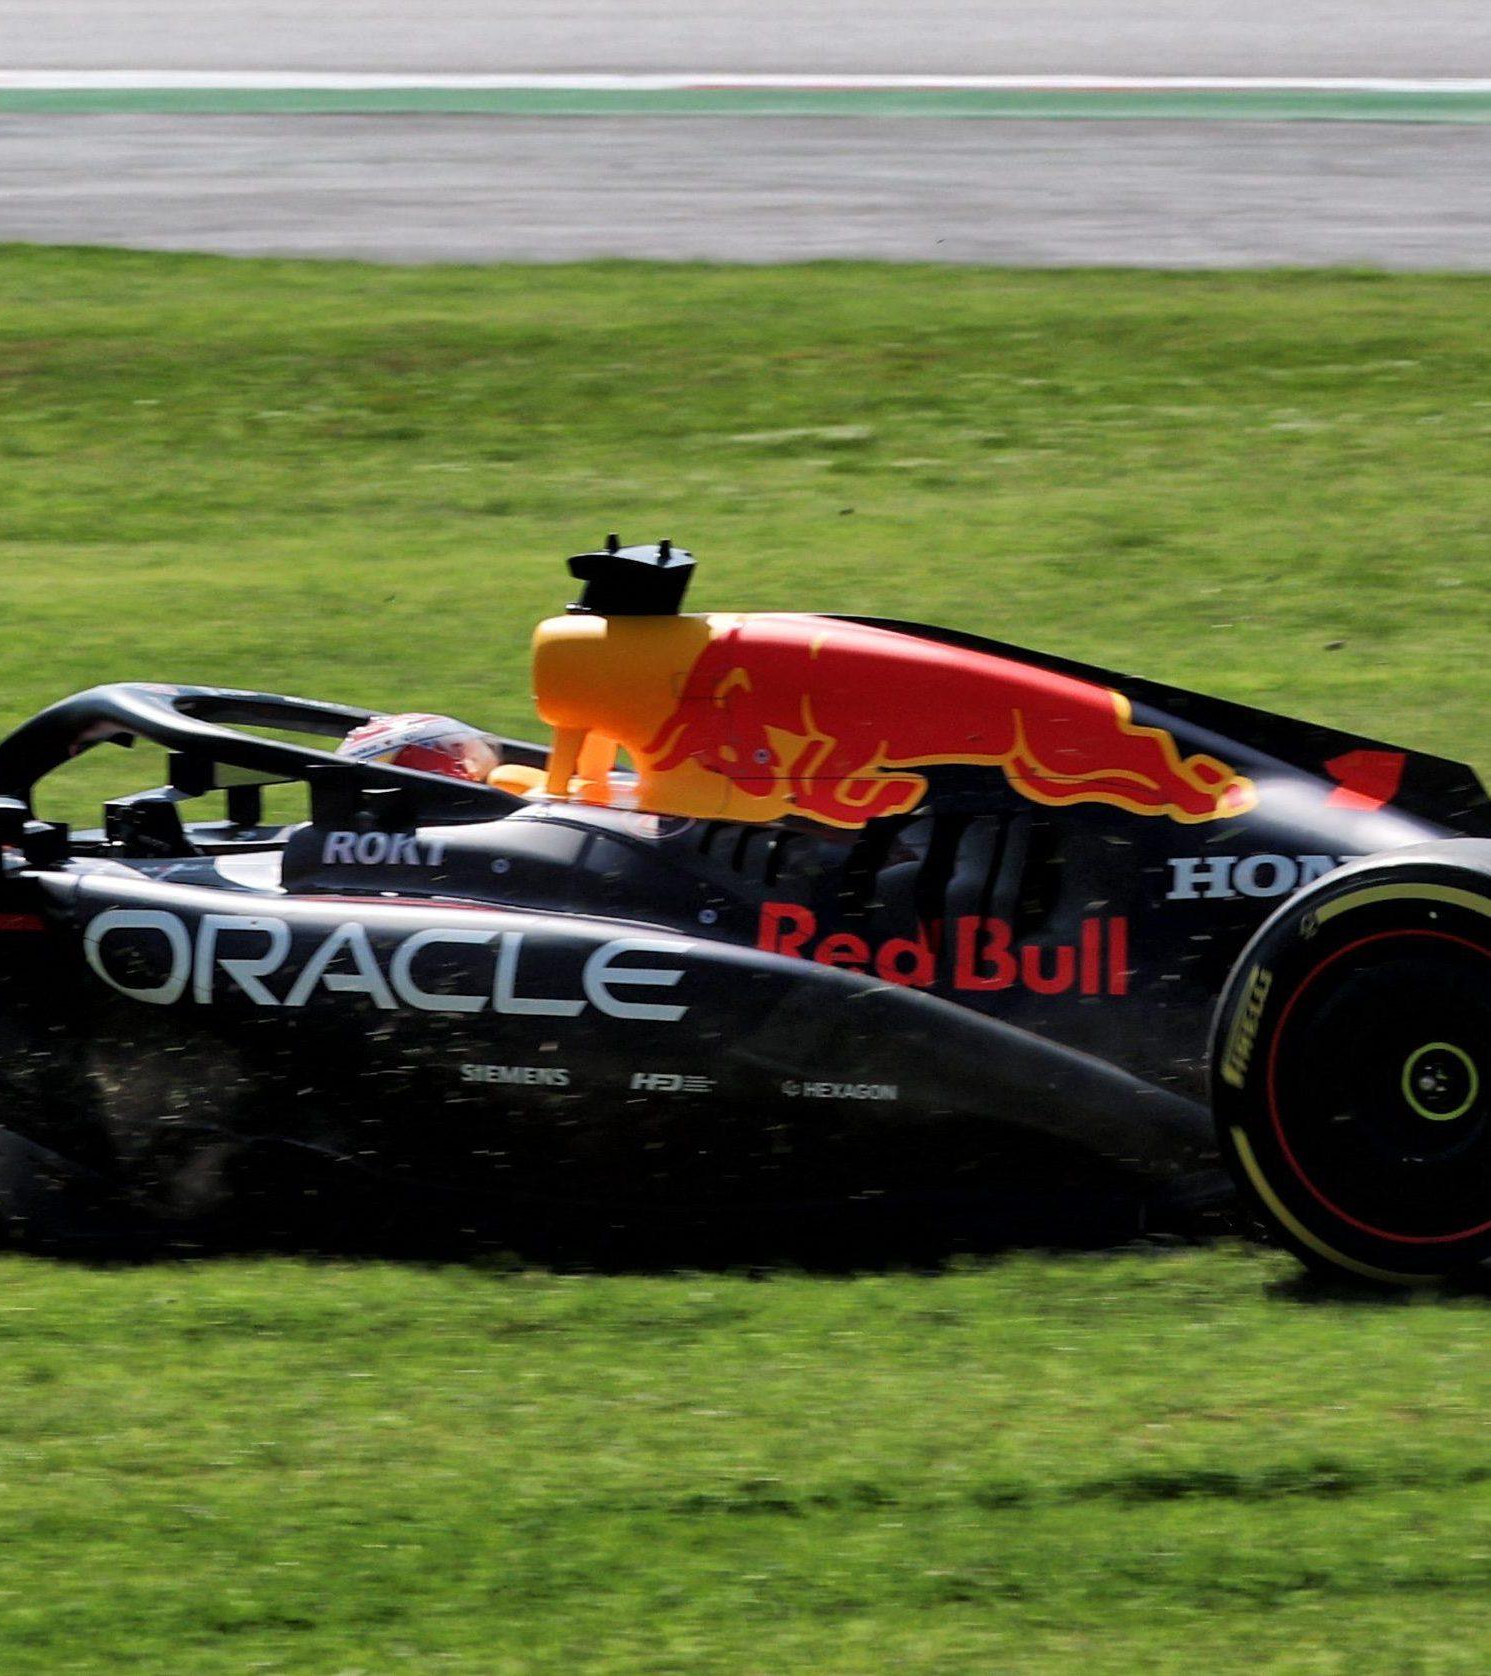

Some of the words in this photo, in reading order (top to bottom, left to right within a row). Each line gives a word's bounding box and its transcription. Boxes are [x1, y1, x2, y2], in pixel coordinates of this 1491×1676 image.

[322, 831, 448, 866] ROKT
[1165, 854, 1366, 899] HON
[83, 908, 693, 1022] ORACLE
[756, 901, 940, 988] Red
[954, 915, 1129, 995] Bull
[460, 1064, 570, 1086] SIEMENS
[803, 1082, 898, 1100] HEXAGON
